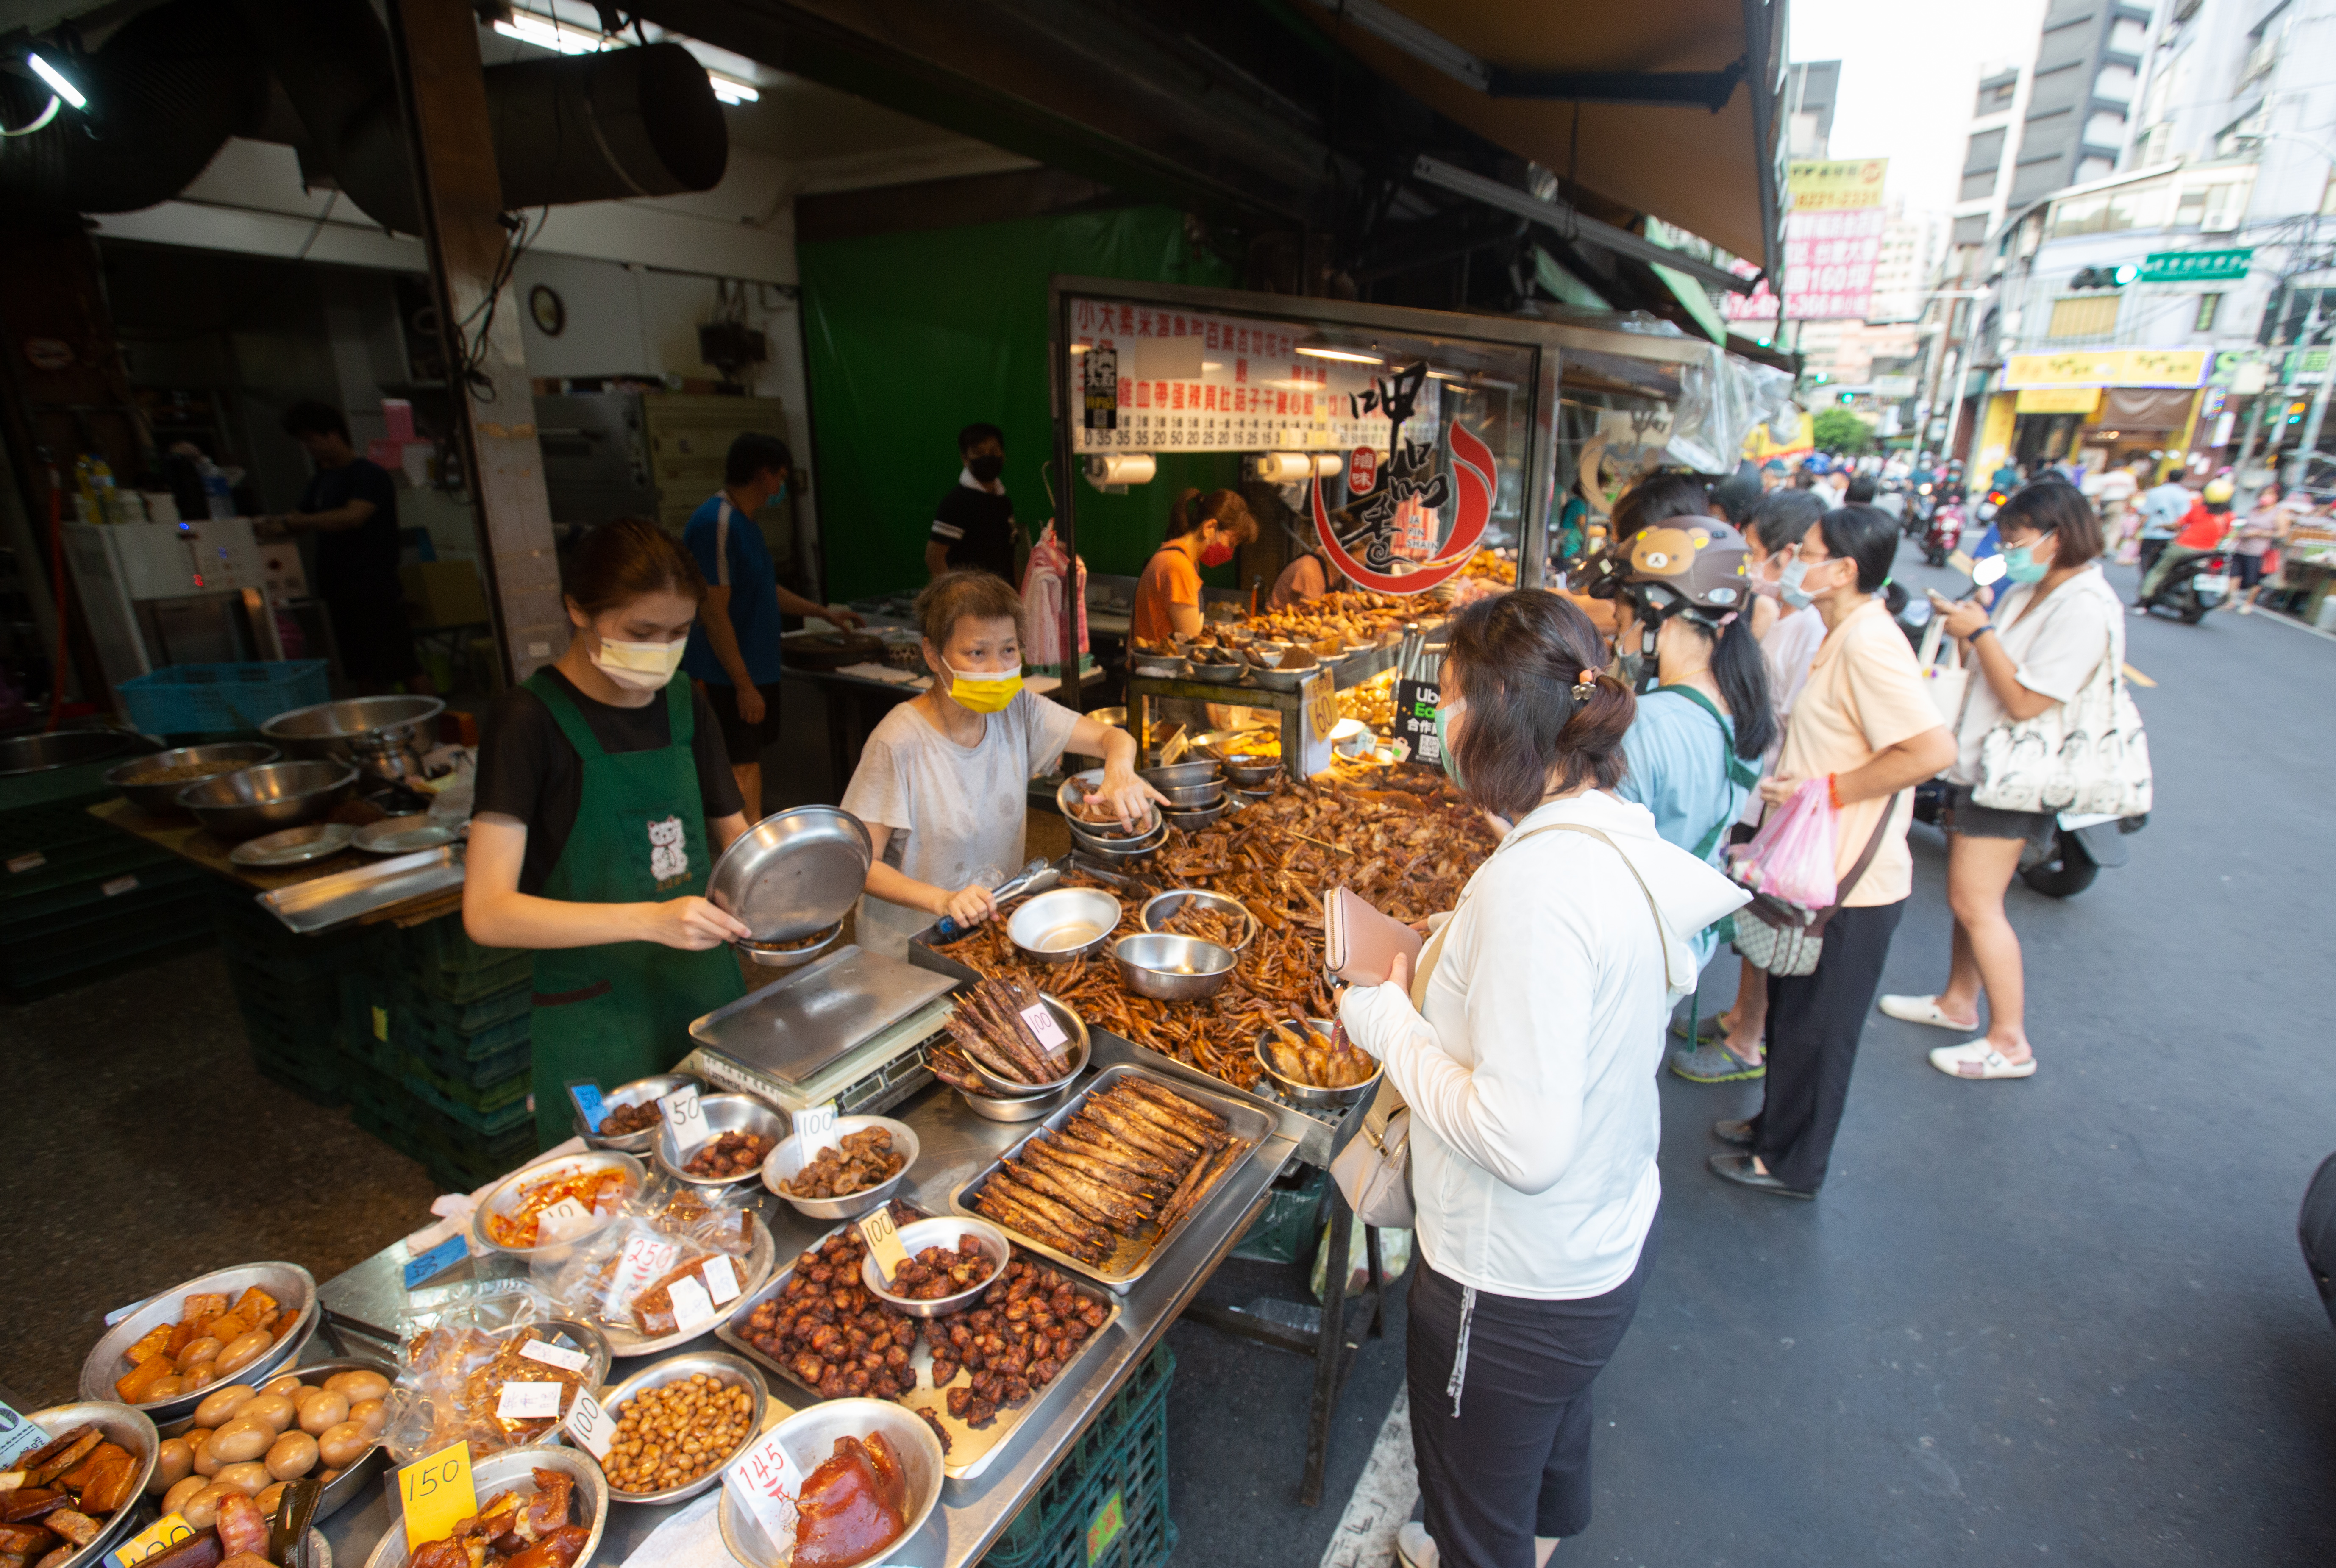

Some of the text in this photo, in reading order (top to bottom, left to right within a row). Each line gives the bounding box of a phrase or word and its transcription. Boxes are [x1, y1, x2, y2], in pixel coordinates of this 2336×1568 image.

[1097, 430, 1111, 445] 35
[1116, 430, 1130, 445] 35
[1135, 430, 1149, 445] 35
[1153, 430, 1166, 444] 20
[1171, 430, 1183, 444] 50
[1187, 430, 1199, 444] 20
[1203, 431, 1214, 444] 25
[1218, 431, 1229, 444] 20
[1234, 431, 1243, 444] 15
[1247, 431, 1257, 444] 25
[1263, 431, 1271, 445] 15
[1352, 453, 1374, 487] 滷味
[1408, 528, 1425, 537] PIN
[1409, 516, 1420, 524] JA
[1416, 687, 1440, 704] Ub
[1315, 696, 1333, 733] 60
[1414, 702, 1435, 719] Ea
[1407, 717, 1437, 735] 合作
[1029, 1012, 1051, 1034] 100
[578, 1092, 600, 1110] 50
[673, 1096, 699, 1125] 50
[803, 1112, 832, 1137] 100
[866, 1214, 892, 1247] 100
[628, 1240, 673, 1268] 250
[573, 1397, 598, 1440] 100
[739, 1443, 784, 1492] 145
[409, 1460, 459, 1501] 150
